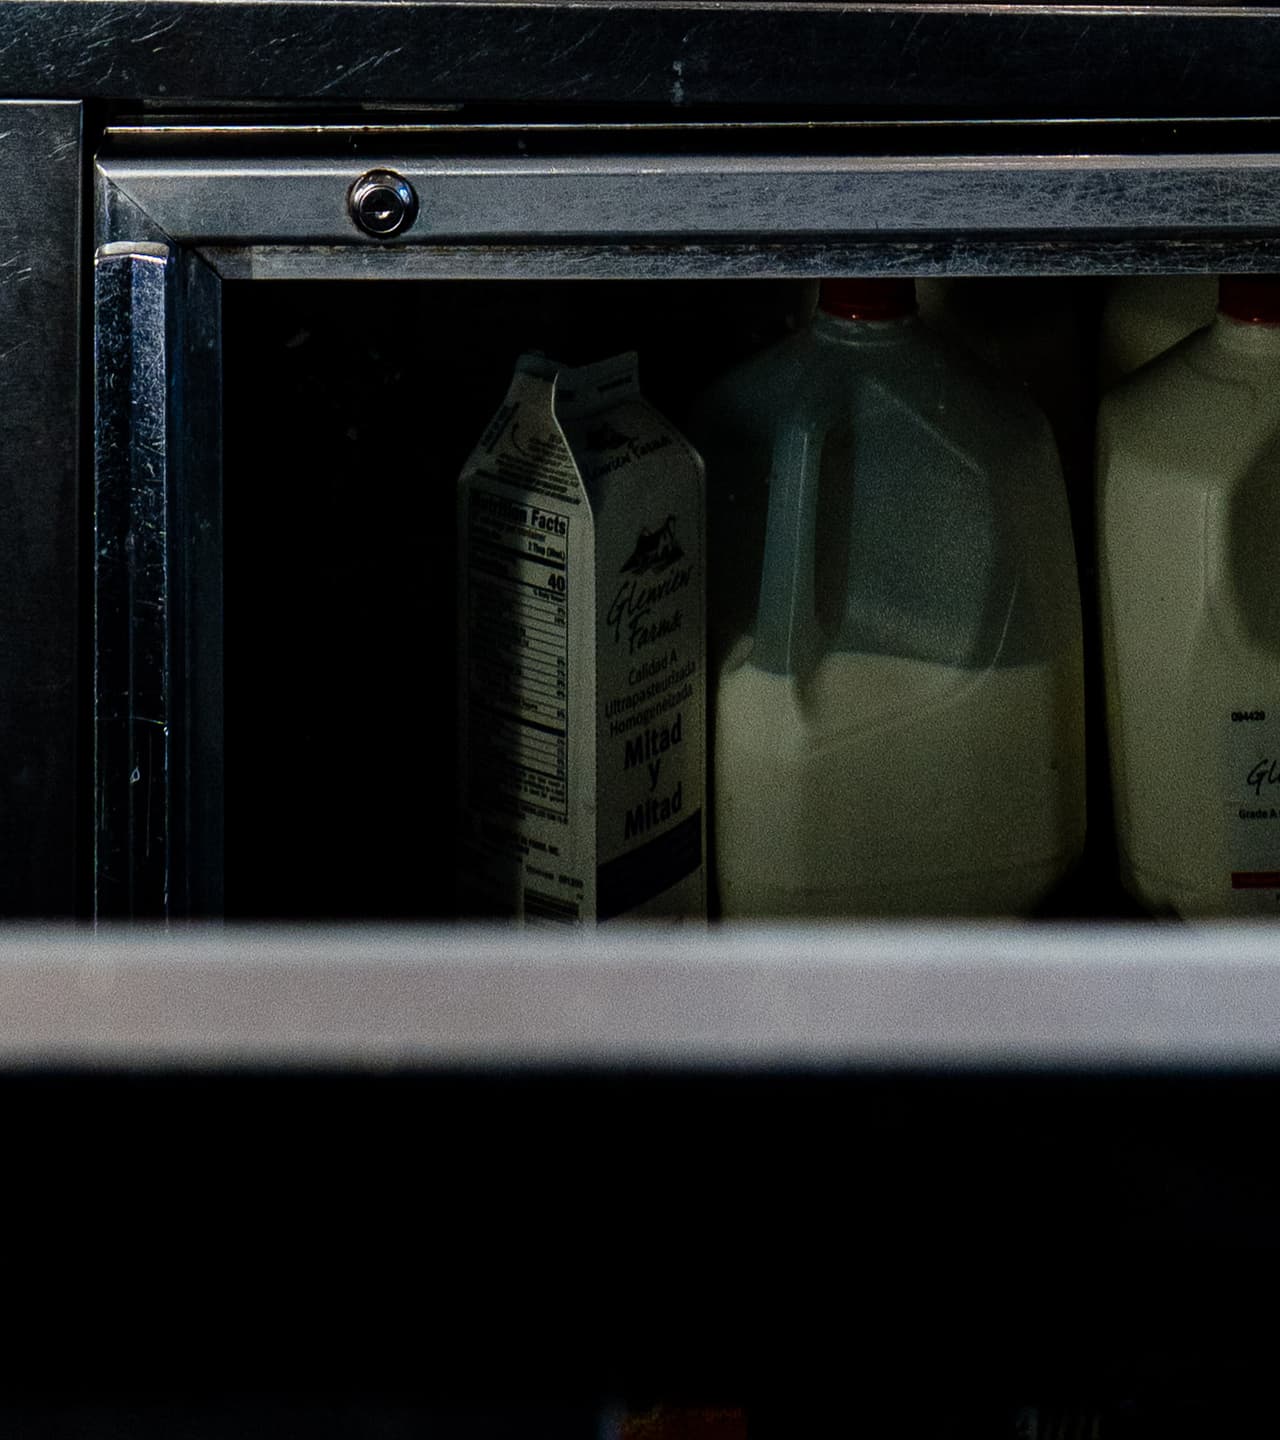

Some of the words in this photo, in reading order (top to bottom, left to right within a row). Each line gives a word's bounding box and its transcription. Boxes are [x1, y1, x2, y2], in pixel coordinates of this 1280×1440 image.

[531, 509, 567, 535] Facts
[547, 575, 566, 591] 40
[606, 565, 694, 627] Glenview
[628, 607, 682, 654] Farms
[605, 659, 697, 717] Ultrapasteurizada
[627, 651, 669, 686] Calidad
[669, 648, 678, 664] A
[609, 682, 694, 737] Homogeneizada
[624, 713, 683, 770] Mitad
[648, 757, 661, 791] y
[624, 781, 683, 841] Mitad
[1239, 808, 1267, 819] Grade
[1269, 809, 1277, 818] A
